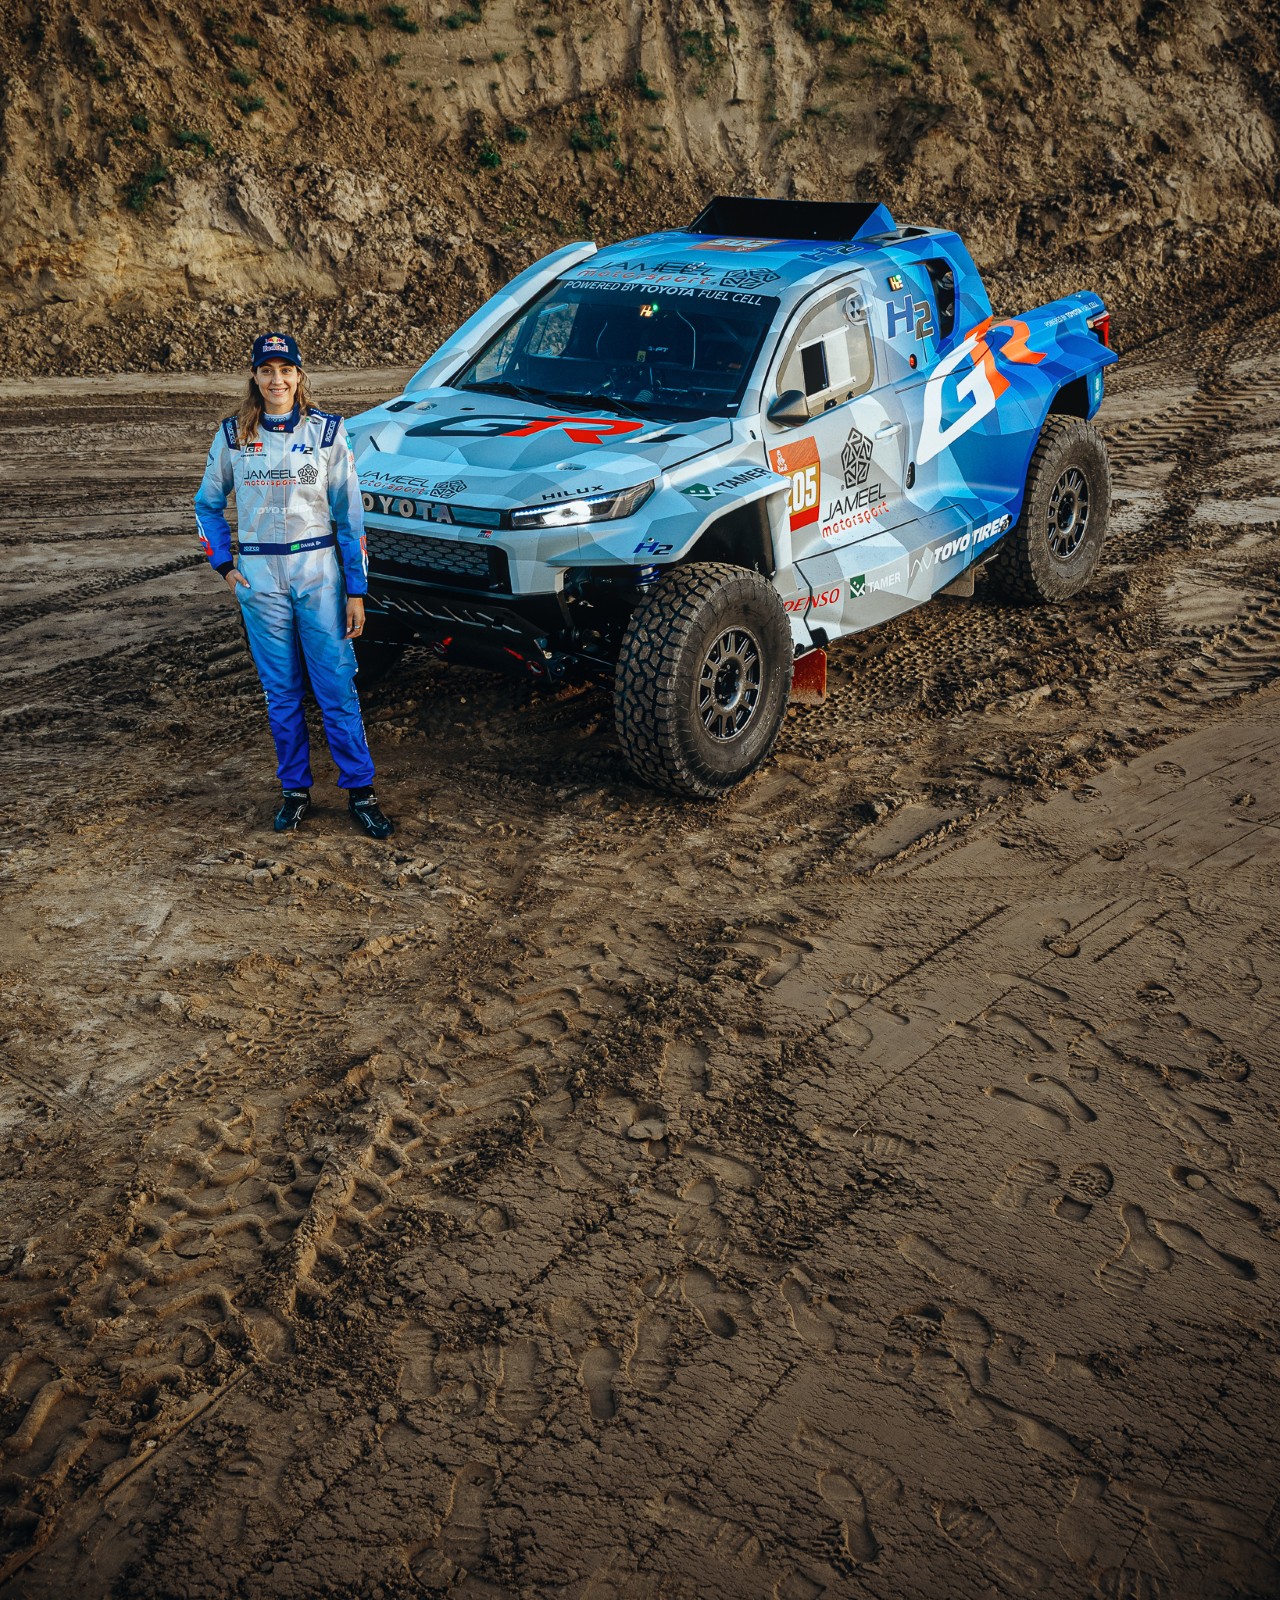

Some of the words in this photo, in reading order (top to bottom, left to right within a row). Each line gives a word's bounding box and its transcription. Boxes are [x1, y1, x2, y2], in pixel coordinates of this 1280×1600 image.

[577, 270, 712, 285] motorsport
[587, 261, 716, 277] JAMEEL
[564, 281, 620, 291] POWERED
[621, 282, 639, 292] BY
[640, 284, 695, 297] TOYOTA
[698, 289, 729, 301] FUEL
[732, 293, 762, 306] CELL
[886, 294, 934, 341] H2
[916, 314, 1048, 466] GR
[405, 415, 644, 444] GR
[291, 443, 314, 454] H2
[244, 470, 296, 479] JAMEEL
[244, 479, 297, 487] motorsport
[358, 470, 429, 488] JAMEEL
[716, 467, 771, 489] TAMER
[360, 480, 426, 495] otorsport
[541, 484, 605, 500] HILUX
[362, 493, 453, 524] OYOTA
[823, 483, 886, 522] JAMEEL
[822, 501, 890, 538] motorsport
[633, 541, 674, 556] H2
[934, 533, 970, 564] TOYO
[868, 572, 900, 593] TAMER
[783, 588, 840, 613] DENSO
